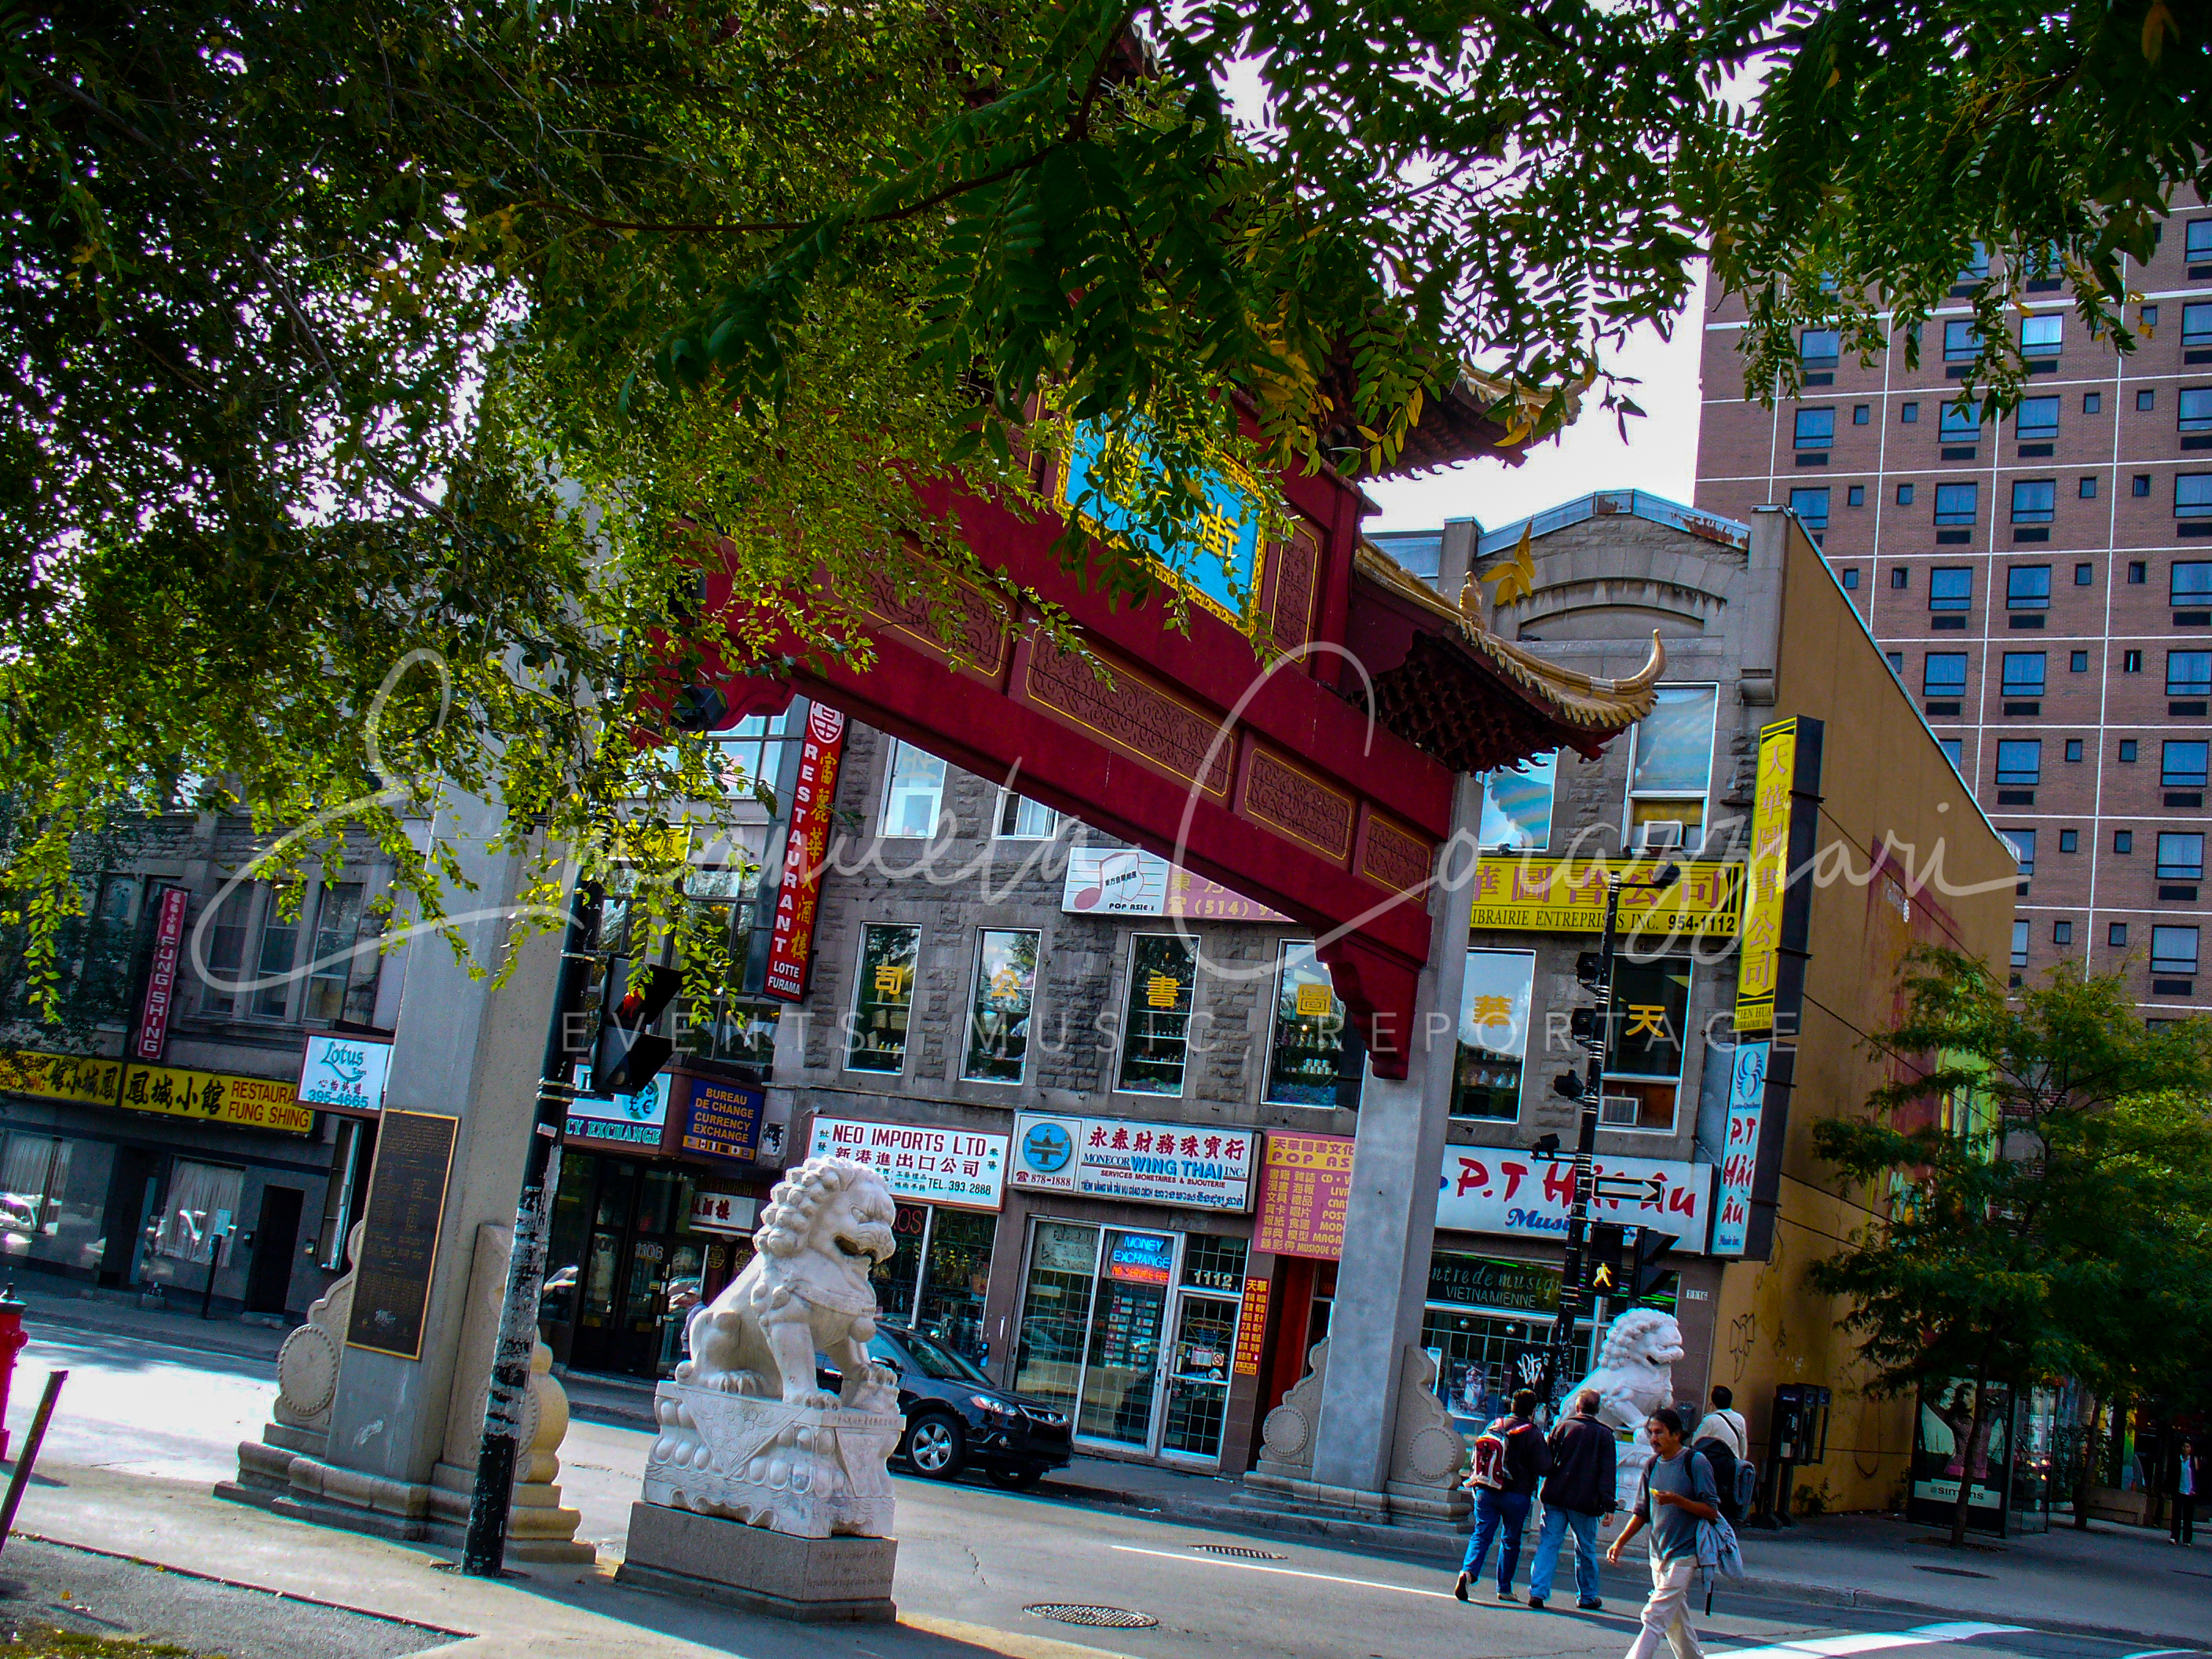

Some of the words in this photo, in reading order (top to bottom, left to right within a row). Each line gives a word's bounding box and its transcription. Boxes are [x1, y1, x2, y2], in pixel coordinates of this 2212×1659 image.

[775, 743, 819, 954] RESTAURANT
[1195, 899, 1249, 916] (514)
[1536, 910, 1624, 930] ENTREPRISS
[1632, 914, 1659, 931] INC.
[1668, 914, 1735, 932] 954-1112
[773, 960, 800, 979] LOTTE
[767, 977, 801, 996] FURAMA
[143, 991, 167, 1052] SHING
[1626, 1004, 1666, 1038] 天
[320, 1041, 365, 1070] Lotus
[230, 1080, 297, 1105] RESTAURA
[705, 1087, 748, 1105] BUREAU
[228, 1101, 265, 1122] FUNG
[268, 1106, 310, 1129] SHING
[694, 1097, 709, 1109] DE
[712, 1101, 754, 1119] CHANGE
[694, 1111, 751, 1132] CURRENCY
[586, 1121, 662, 1144] EXCHANGE
[692, 1123, 749, 1143] EXCHANGE
[832, 1124, 866, 1144] NEO
[871, 1127, 945, 1152] IMPORTS
[952, 1136, 987, 1158] LTD
[1082, 1152, 1130, 1170] MONECOR
[1130, 1155, 1178, 1176] WING
[1181, 1160, 1225, 1181] THAI
[1225, 1166, 1246, 1178] INC.
[1272, 1151, 1314, 1164] POP
[1326, 1155, 1350, 1168] AS
[1030, 1174, 1071, 1188] 878-1888
[1100, 1170, 1133, 1179] SERVICES
[1135, 1173, 1177, 1183] MONETAIRES
[1187, 1178, 1226, 1189] BIJOUTERIE
[1321, 1174, 1333, 1184] CD
[1456, 1156, 1529, 1203] P.T
[1266, 1191, 1287, 1204] 文具
[1322, 1210, 1347, 1221] POST
[1504, 1207, 1573, 1232] Musi
[1320, 1221, 1344, 1232] MOD
[1123, 1236, 1165, 1252] MONEY
[1298, 1242, 1330, 1254] MUSIQUE
[1313, 1232, 1343, 1244] MAGA
[1112, 1249, 1171, 1269] EXCHANGE
[1194, 1269, 1233, 1288] 1112
[1445, 1285, 1537, 1309] VIETNAMIENNE
[1937, 1487, 1984, 1500] simns
